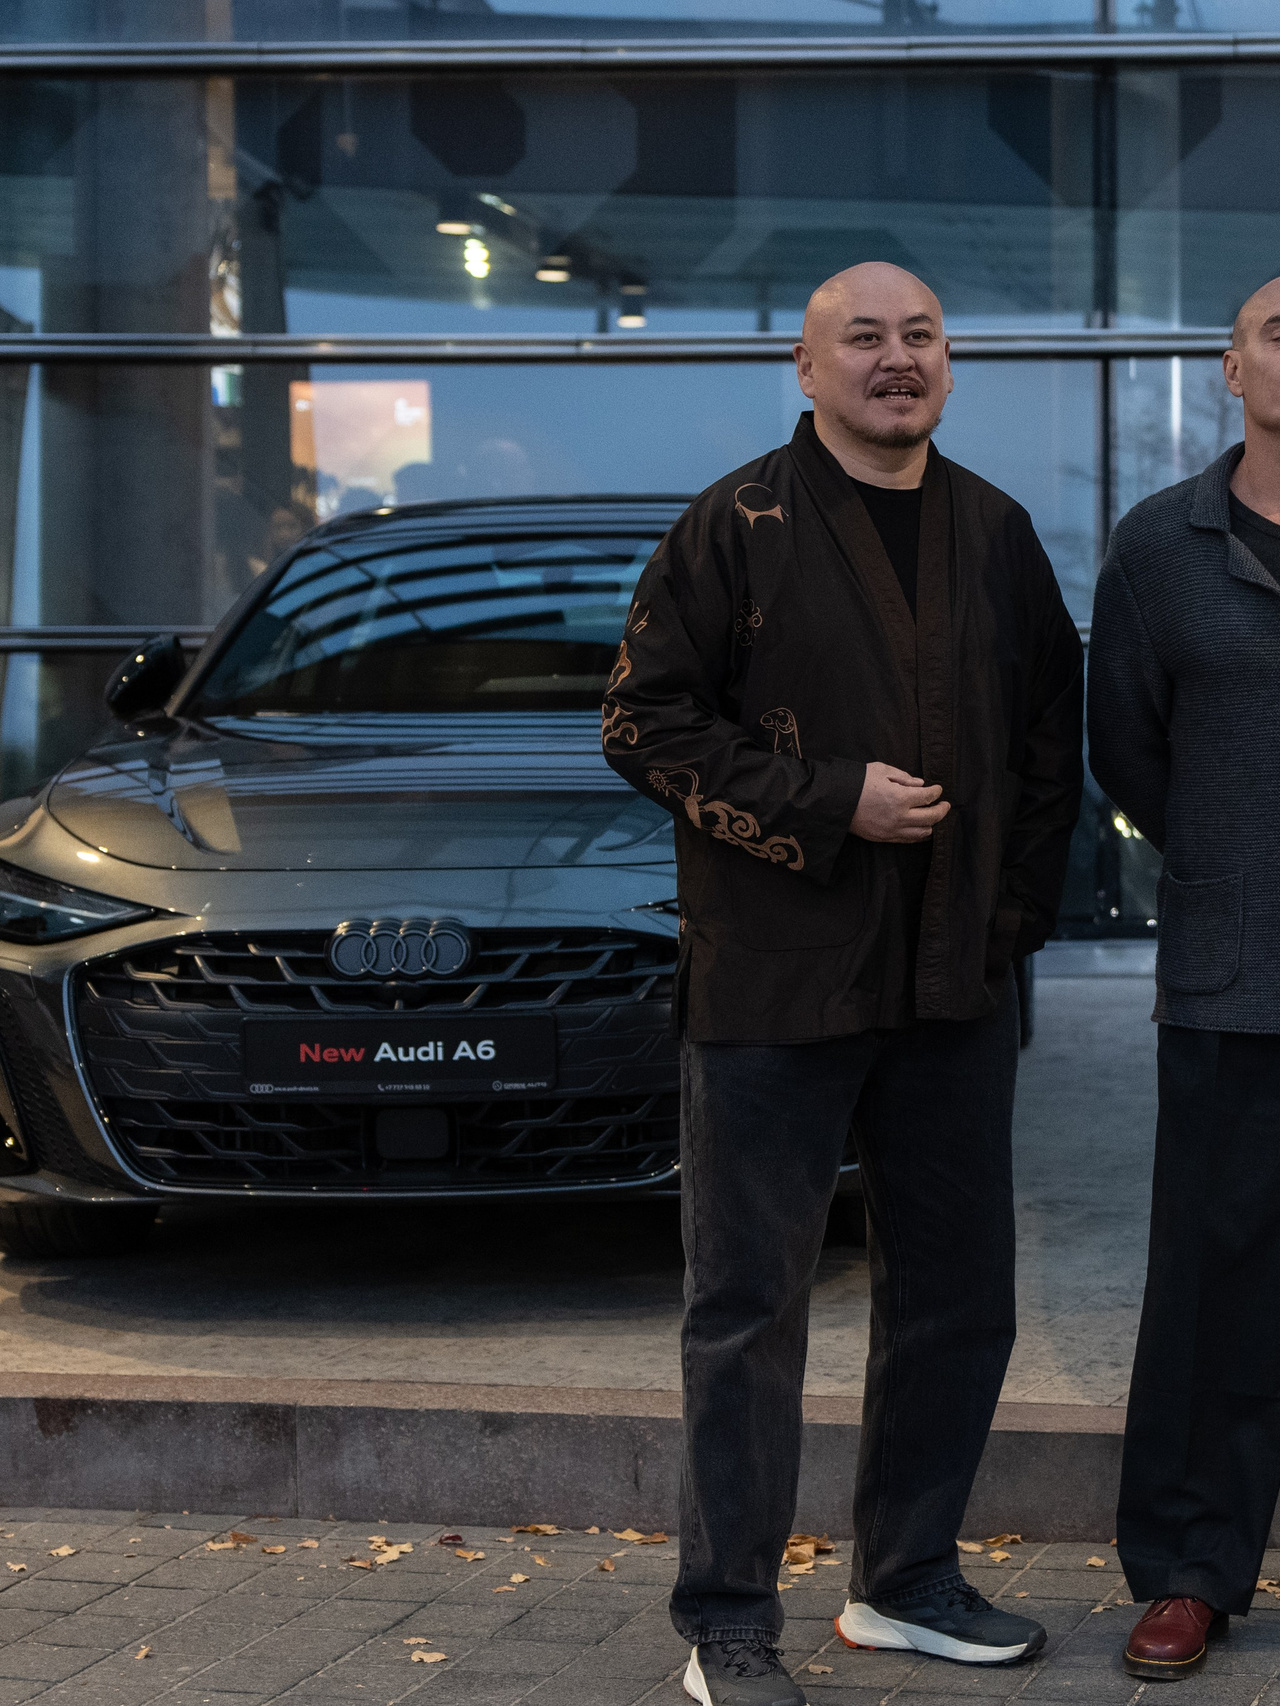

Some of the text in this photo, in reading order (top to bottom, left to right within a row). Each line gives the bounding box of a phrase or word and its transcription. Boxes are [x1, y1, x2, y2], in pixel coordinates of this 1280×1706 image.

[299, 1039, 497, 1063] New Audi A6
